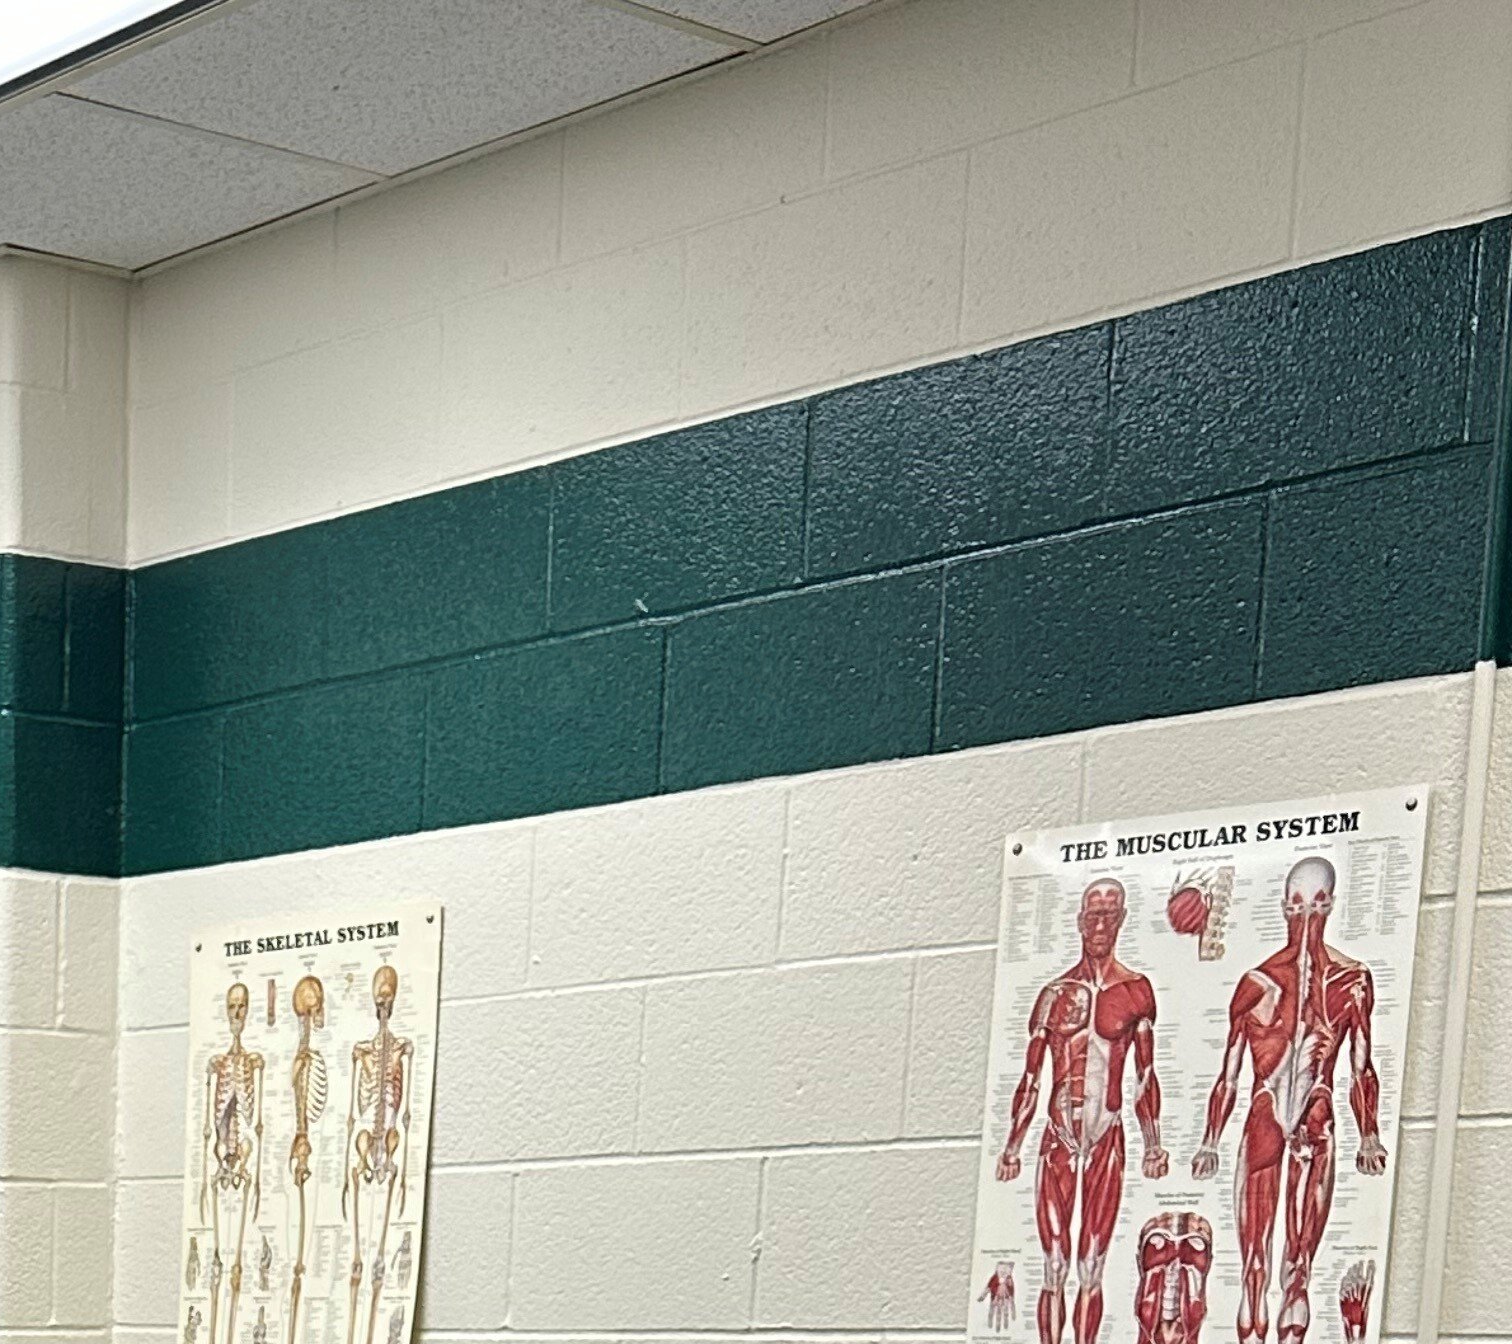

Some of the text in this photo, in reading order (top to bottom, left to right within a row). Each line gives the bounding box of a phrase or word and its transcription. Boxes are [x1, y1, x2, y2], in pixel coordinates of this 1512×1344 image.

[1060, 811, 1361, 863] THE MUSCULAR SYSTEM
[224, 920, 400, 957] THE SKELETAL SYSTEM
